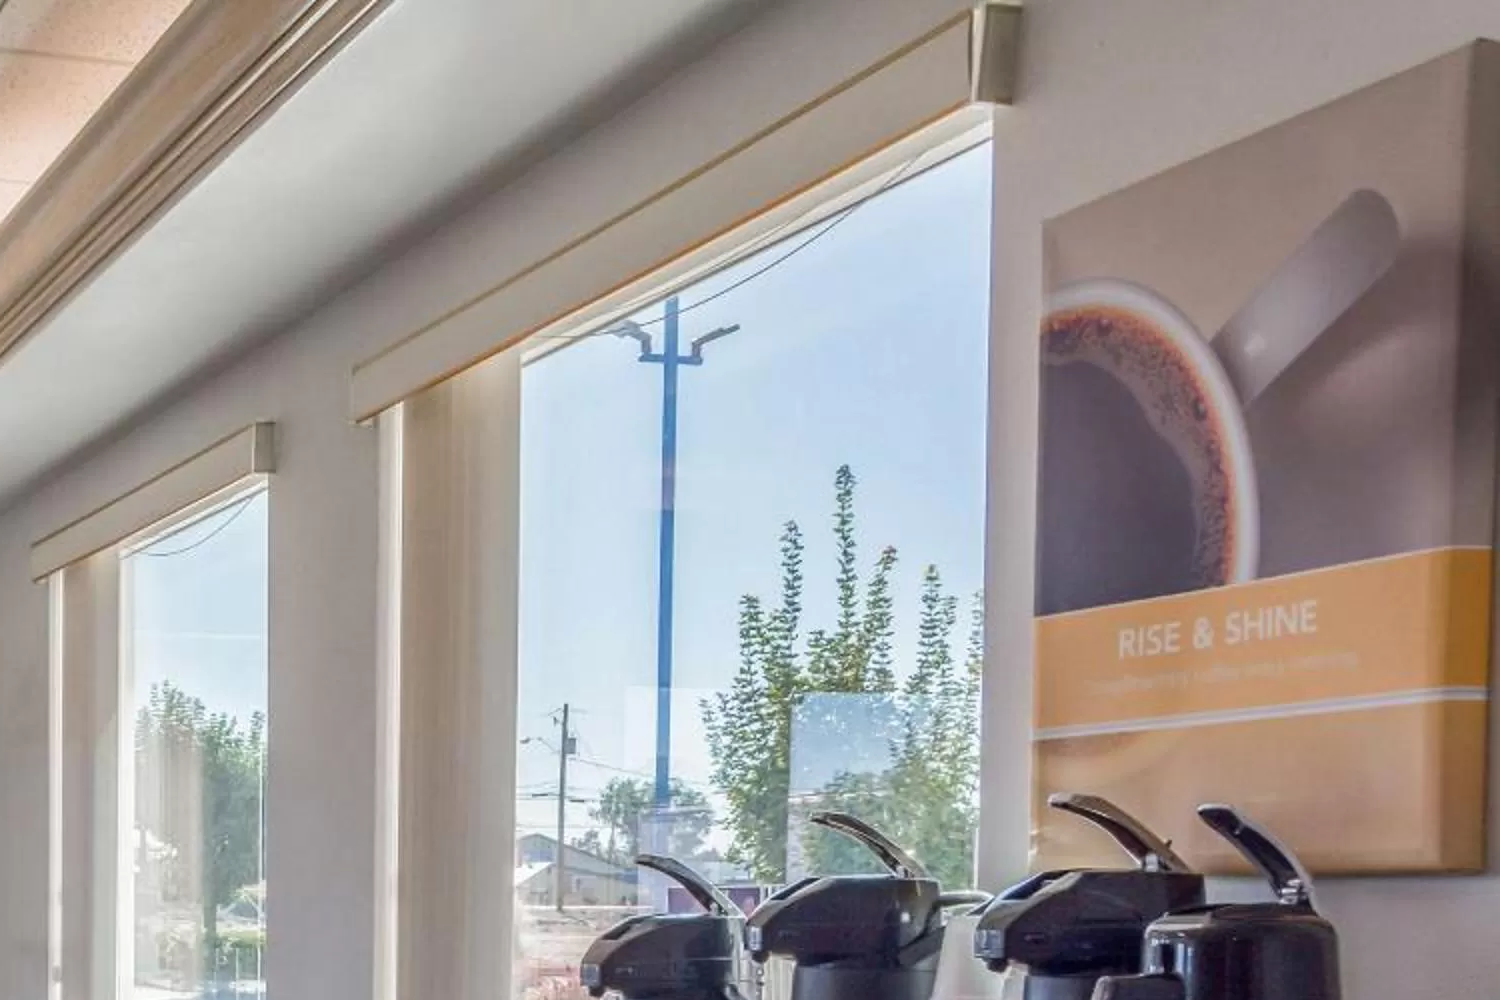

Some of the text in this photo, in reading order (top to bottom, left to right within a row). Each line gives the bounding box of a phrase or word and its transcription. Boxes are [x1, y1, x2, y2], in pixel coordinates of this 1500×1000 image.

[1118, 599, 1318, 660] RISE & SHINE
